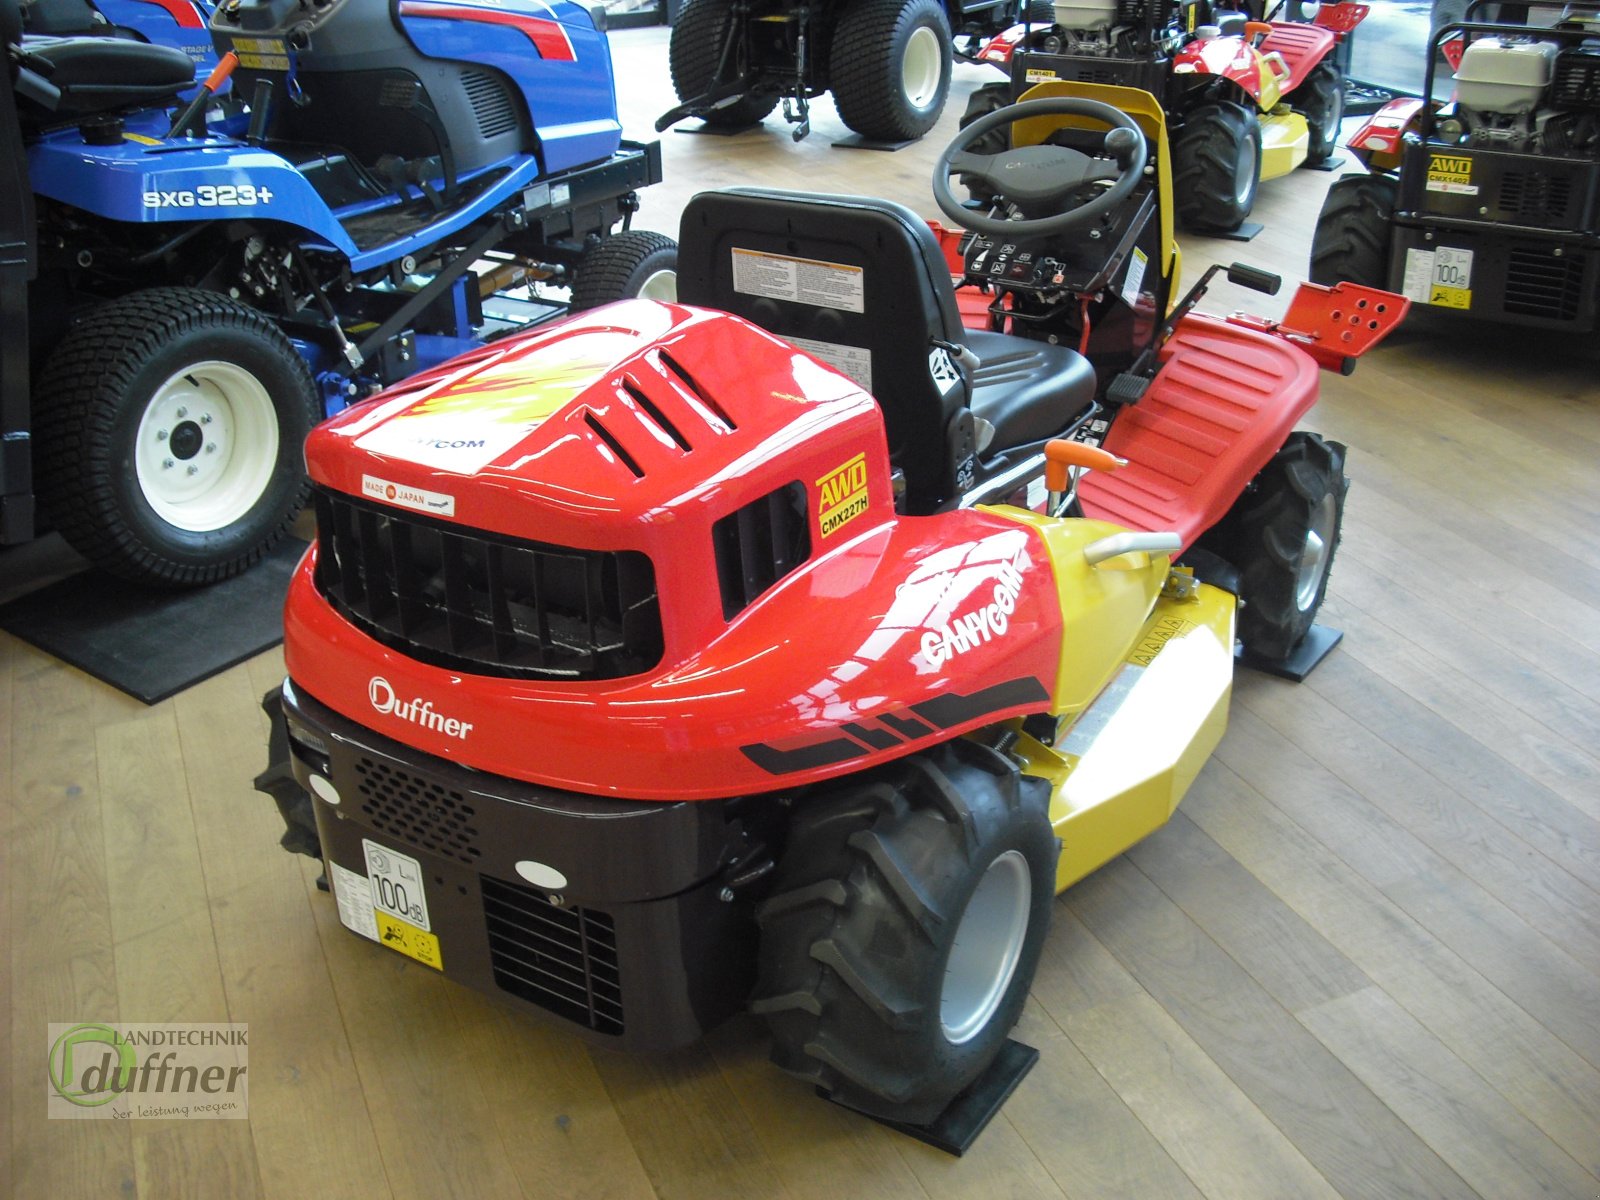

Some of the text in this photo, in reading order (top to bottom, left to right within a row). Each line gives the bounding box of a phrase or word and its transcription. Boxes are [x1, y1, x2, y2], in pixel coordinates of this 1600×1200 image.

[1429, 158, 1472, 174] AWD
[1429, 174, 1468, 185] CMX1402
[364, 481, 384, 494] MADE
[398, 491, 425, 504] JAPAN
[818, 459, 868, 515] AWD
[821, 495, 868, 535] CMX227H
[920, 552, 1024, 667] CANYCOM
[368, 675, 474, 740] Duffner
